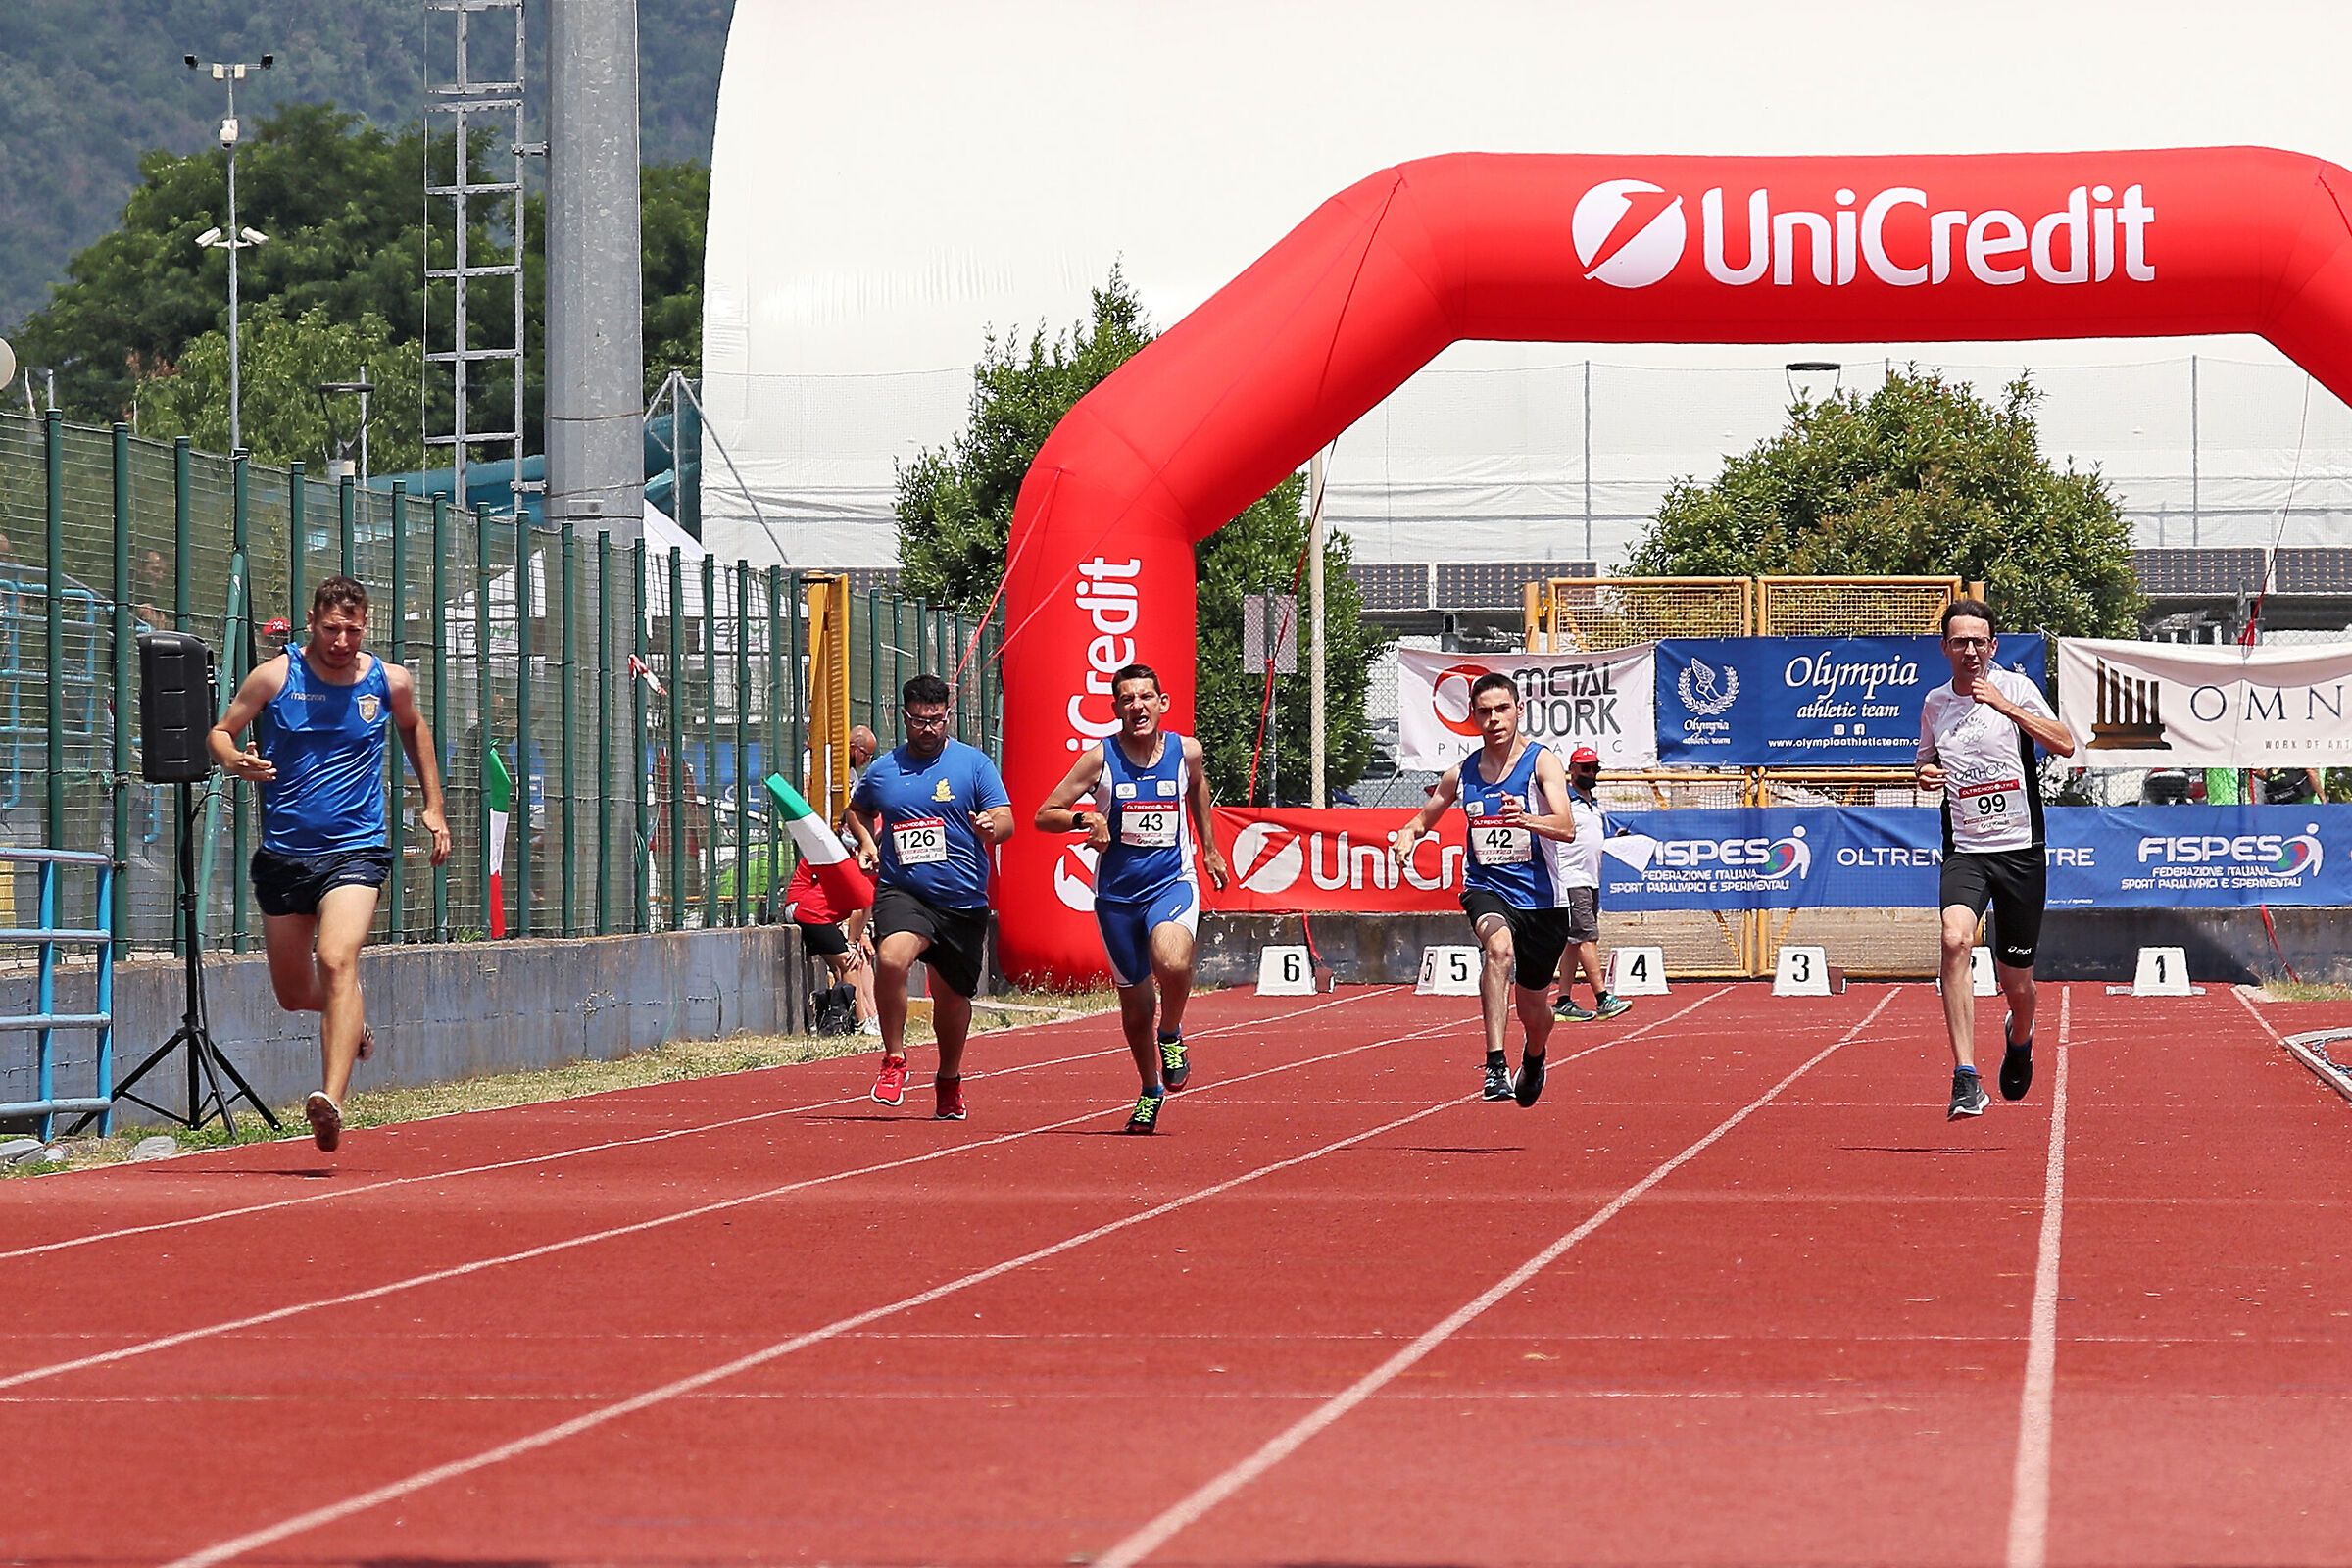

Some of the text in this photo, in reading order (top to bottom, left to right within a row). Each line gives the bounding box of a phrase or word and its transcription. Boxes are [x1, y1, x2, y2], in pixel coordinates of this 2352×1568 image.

[1701, 184, 2156, 287] UniCredit
[1785, 651, 1919, 700] Olympia
[290, 691, 326, 703] macron
[1517, 697, 1622, 737] WORK
[1796, 701, 1900, 718] athletic team
[1438, 739, 1624, 756] PNATIC
[1768, 737, 1921, 749] www.olympiaathleticteam.c
[1978, 794, 2006, 814] 99
[1139, 813, 1163, 831] 43
[900, 830, 936, 849] 126
[1486, 829, 1513, 849] 42
[2137, 835, 2284, 863] FISPES
[1310, 830, 1467, 890] UniCr
[1654, 838, 1771, 866] ISPES
[1642, 868, 1757, 881] FEDERAZIONE ITALIANA
[2152, 865, 2270, 877] FEDERAZIONE ITALIANA
[1609, 883, 1642, 894] SPORT
[1710, 882, 1717, 892] E
[1720, 880, 1789, 893] SPERIMENTALI
[2121, 879, 2155, 890] SPORT
[2222, 878, 2230, 889] E
[2232, 877, 2302, 889] SPERIMENTALI
[1284, 954, 1300, 981] 6
[1424, 953, 1434, 981] 5
[1450, 953, 1467, 981] 5
[1631, 954, 1647, 982] 4
[1792, 954, 1810, 982] 3
[2155, 955, 2166, 983] 1
